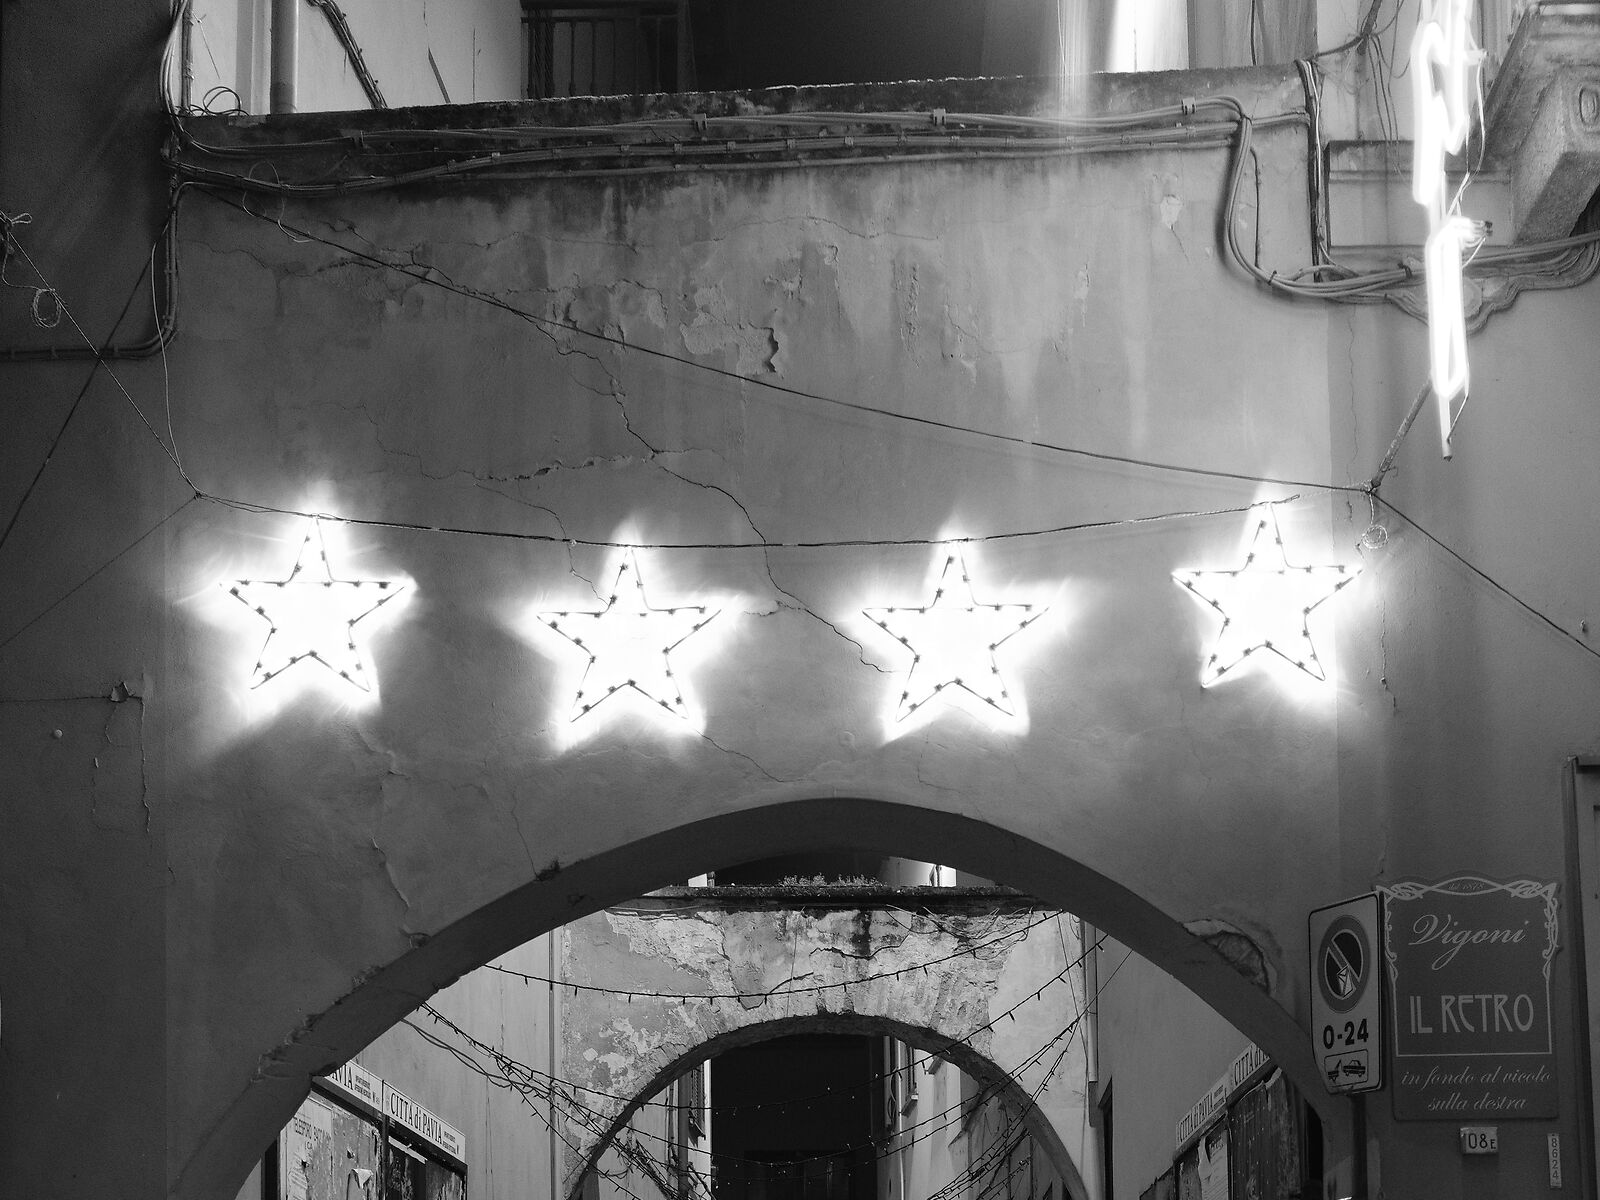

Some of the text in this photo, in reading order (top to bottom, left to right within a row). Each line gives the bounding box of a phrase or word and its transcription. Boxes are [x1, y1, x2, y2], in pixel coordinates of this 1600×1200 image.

[1407, 913, 1530, 971] Vigoni
[1409, 994, 1534, 1034] IL RETRO
[1322, 1018, 1369, 1050] 0-24
[1401, 1064, 1551, 1094] in fondo al vicolo
[1427, 1091, 1527, 1111] sulla destra
[422, 1113, 443, 1145] PAVIA
